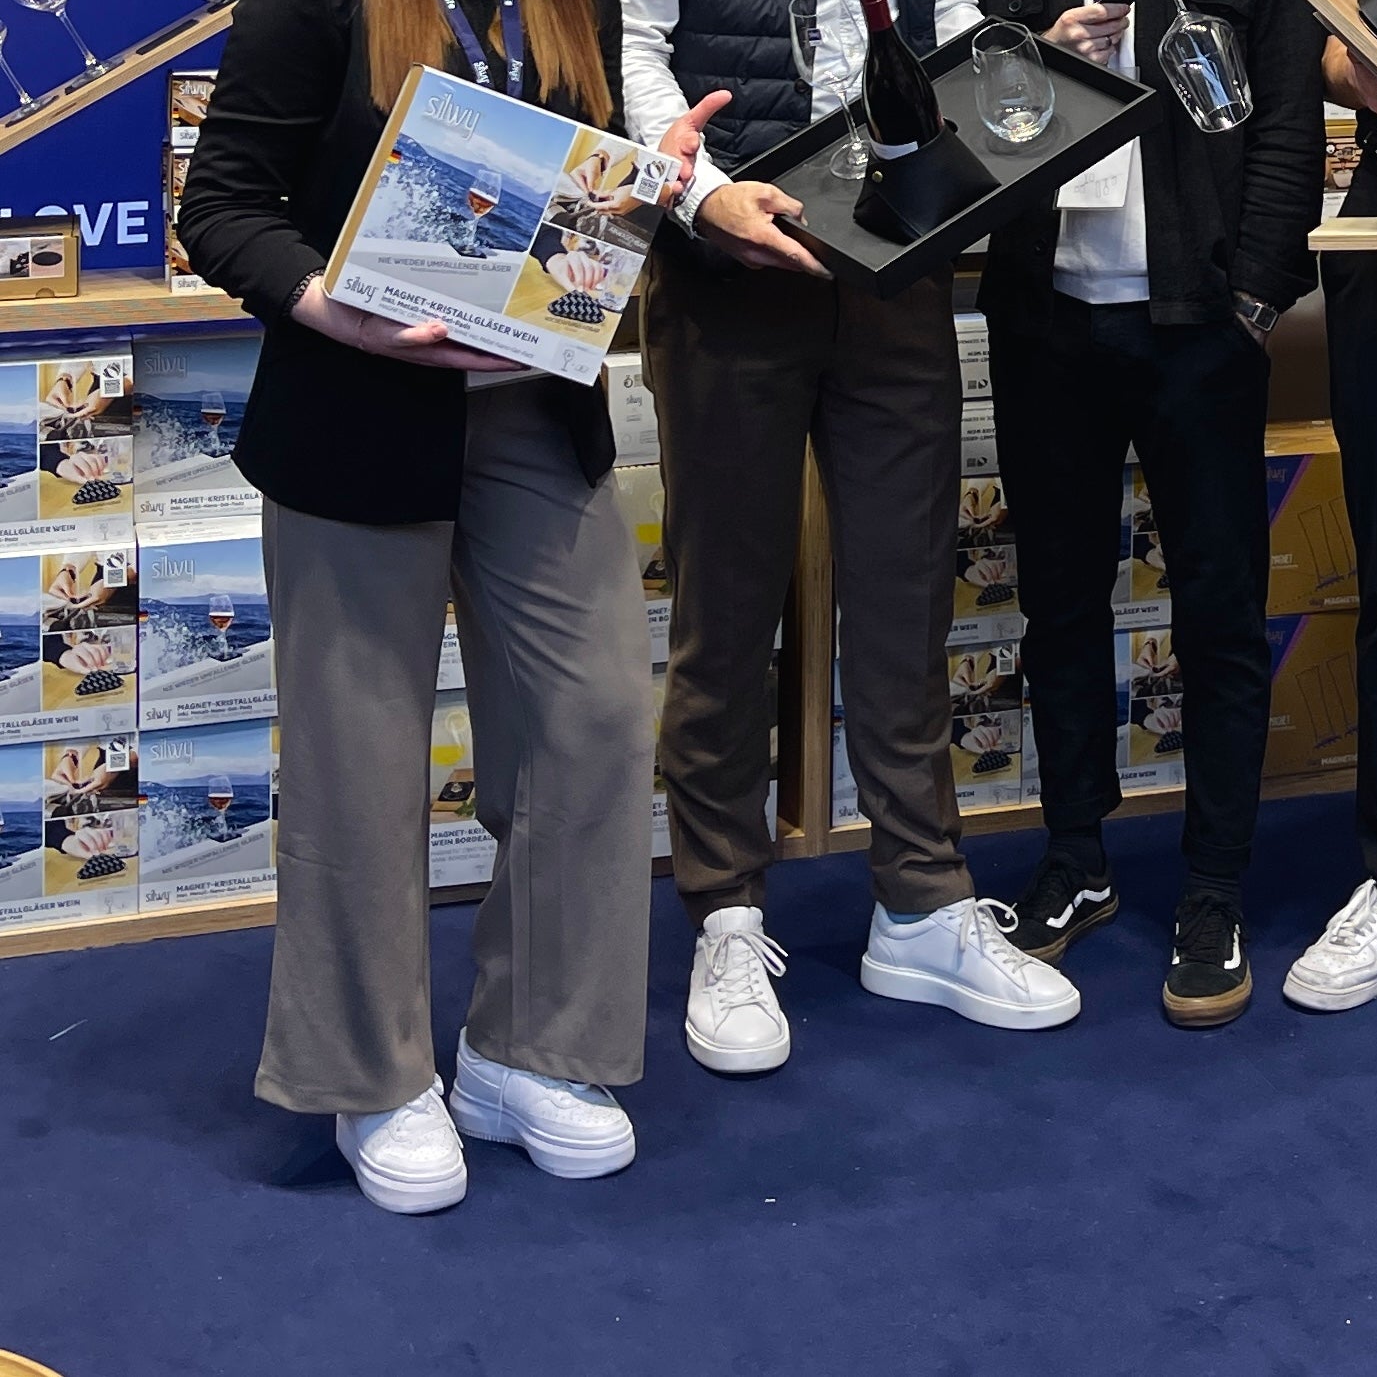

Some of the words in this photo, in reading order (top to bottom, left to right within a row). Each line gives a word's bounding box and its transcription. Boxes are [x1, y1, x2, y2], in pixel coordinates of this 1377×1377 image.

[179, 82, 206, 100] silwy
[423, 92, 481, 141] silwy
[378, 257, 391, 265] NIE
[394, 258, 425, 268] WIEDER
[427, 259, 480, 271] UMFALLENDE
[481, 262, 512, 272] GLÄSER
[344, 276, 379, 304] silwy
[384, 286, 512, 334] MAGNET-KRISTALLGLÄSER
[512, 328, 539, 344] WEIN
[145, 349, 190, 378] silwy
[140, 500, 167, 516] silwy
[170, 492, 263, 505] MAGNET-KRISTALLGLÄ
[52, 523, 76, 534] WEIN
[151, 556, 195, 583] silwy
[56, 715, 79, 726] WEIN
[146, 707, 172, 724] silwy
[177, 693, 277, 711] MAGNET-KRISTALLGLÄSE
[150, 737, 194, 766] silwy
[431, 827, 485, 839] MAGNET-KRIS
[431, 837, 454, 847] WEIN
[455, 834, 495, 845] BORDEAU
[146, 890, 171, 905] silwy
[176, 874, 276, 893] MAGNET-KRISTALLGLÄSE
[57, 899, 81, 910] WEIN
